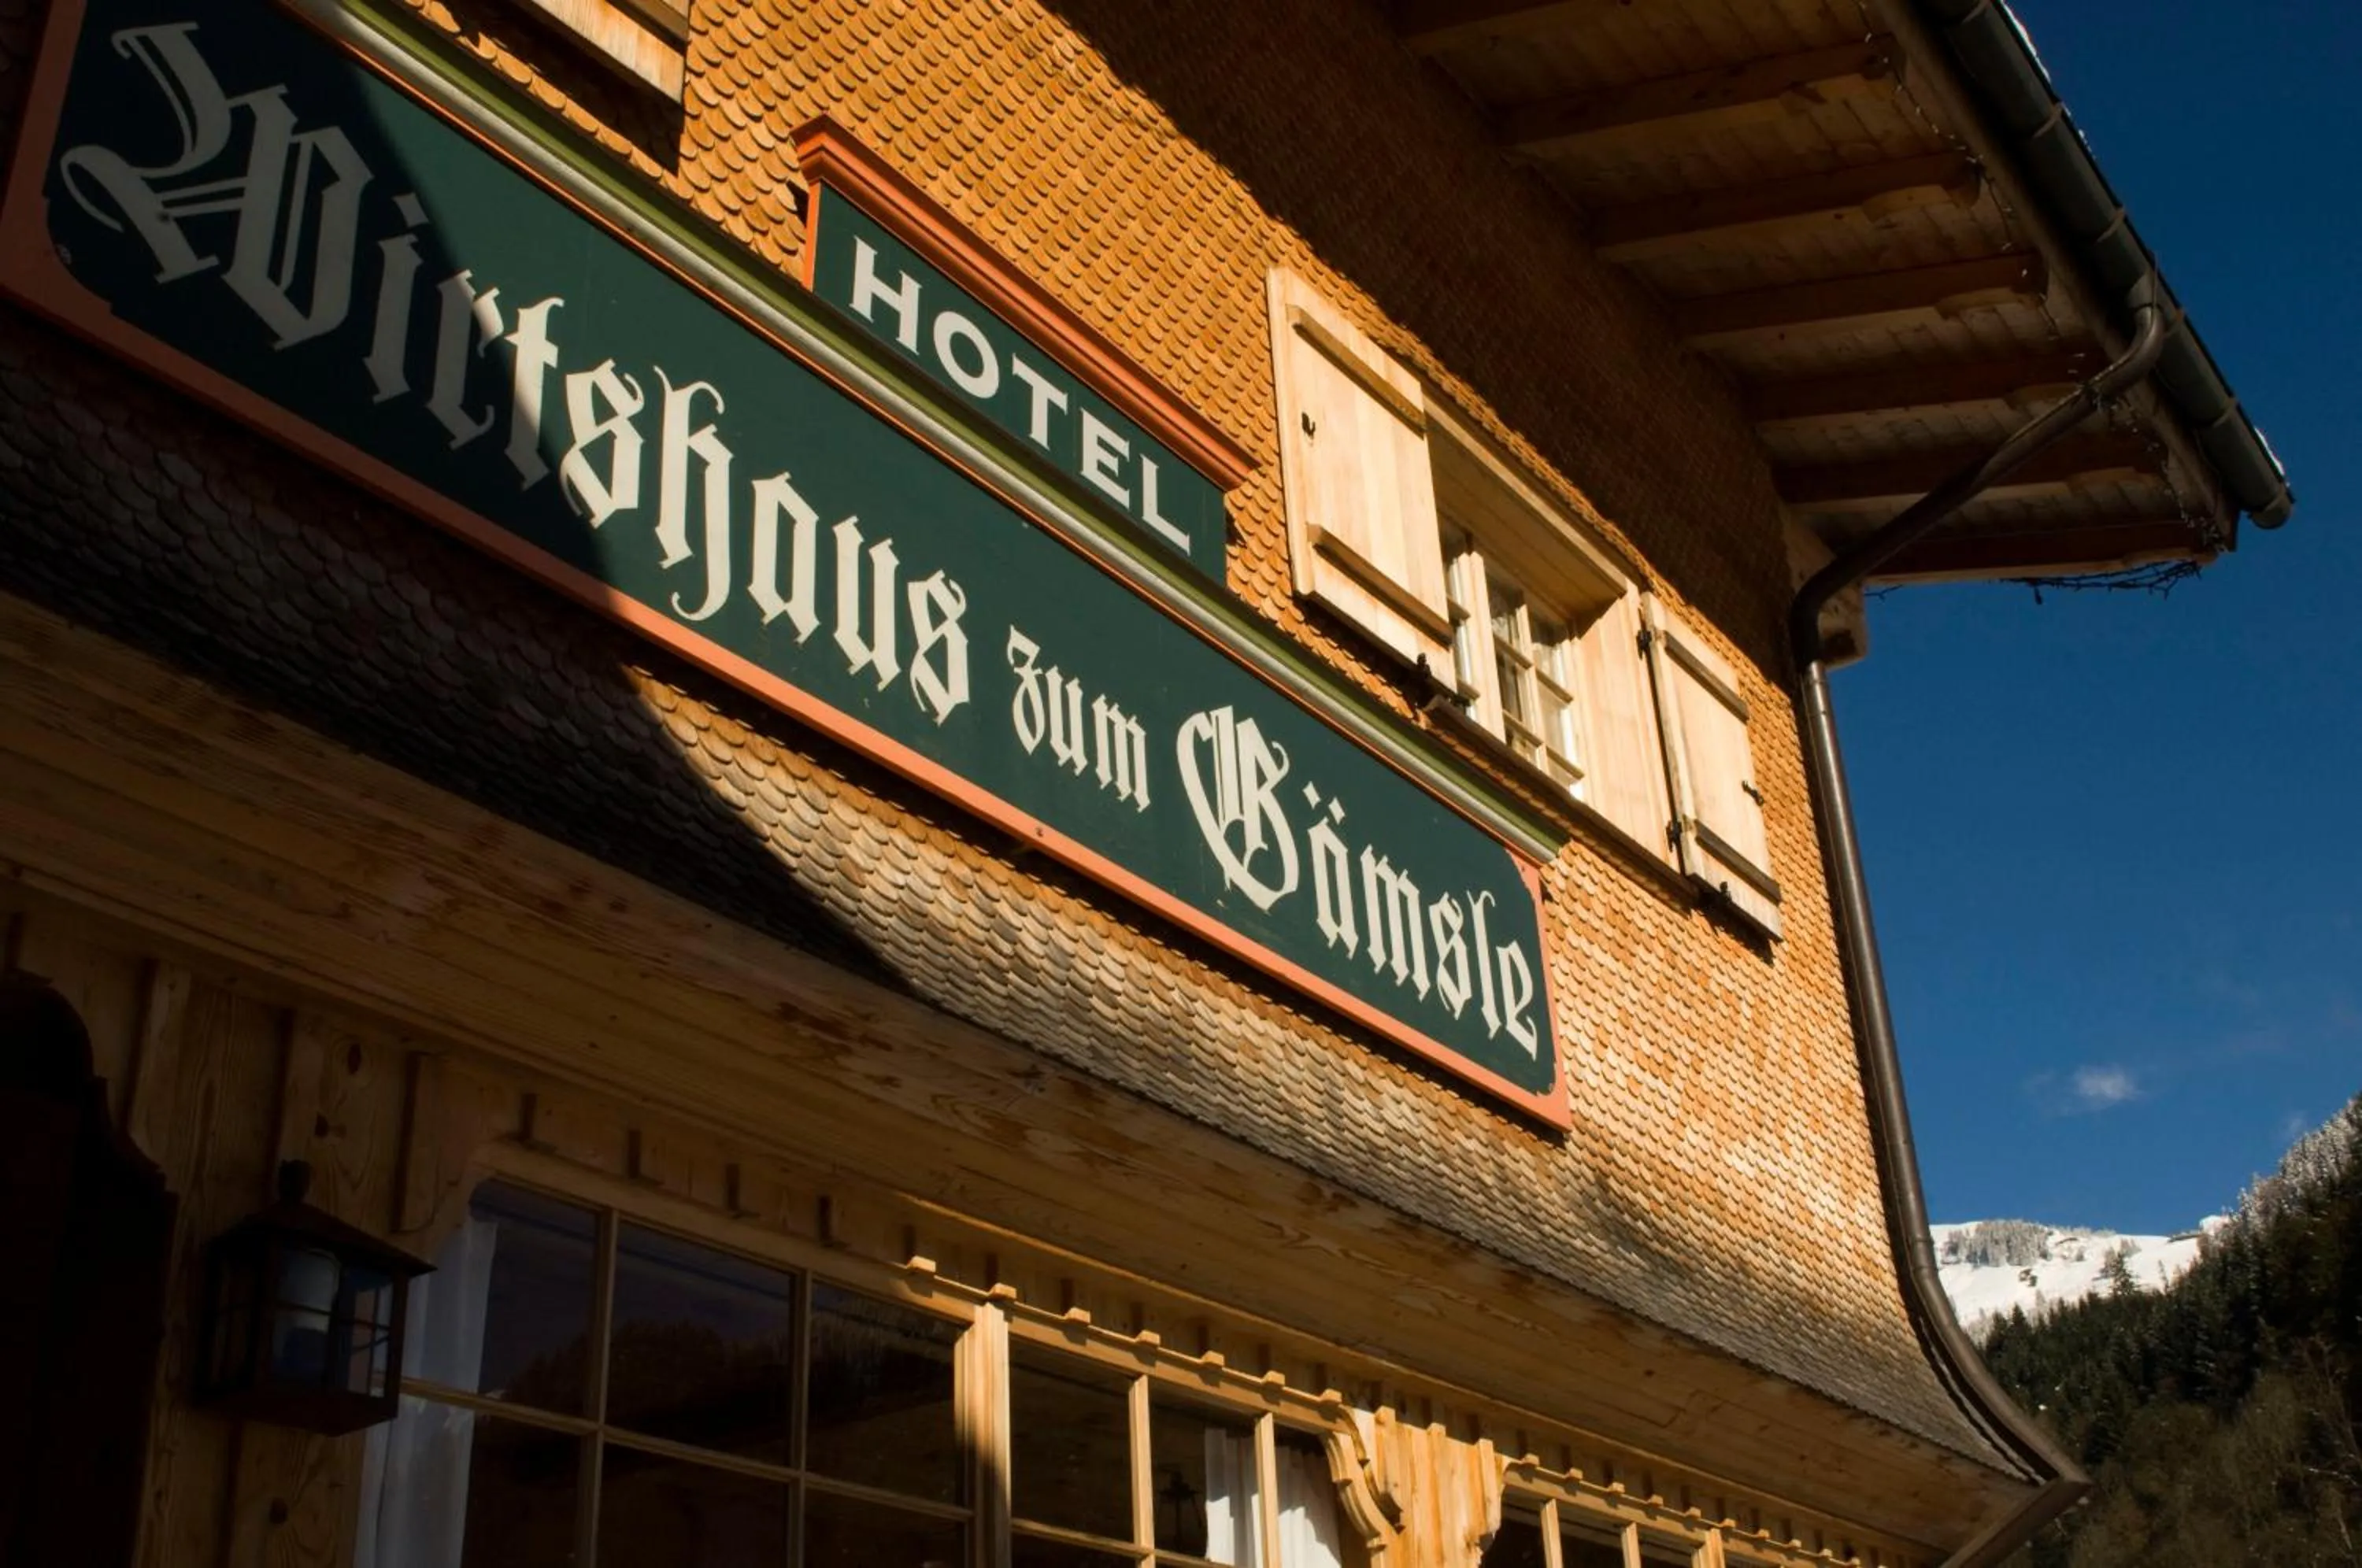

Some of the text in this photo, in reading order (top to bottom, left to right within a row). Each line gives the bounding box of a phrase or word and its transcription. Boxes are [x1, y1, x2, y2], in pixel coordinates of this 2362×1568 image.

[61, 21, 1538, 1061] Wirtshaus zum Gämsle
[850, 235, 1190, 556] HOTEL
